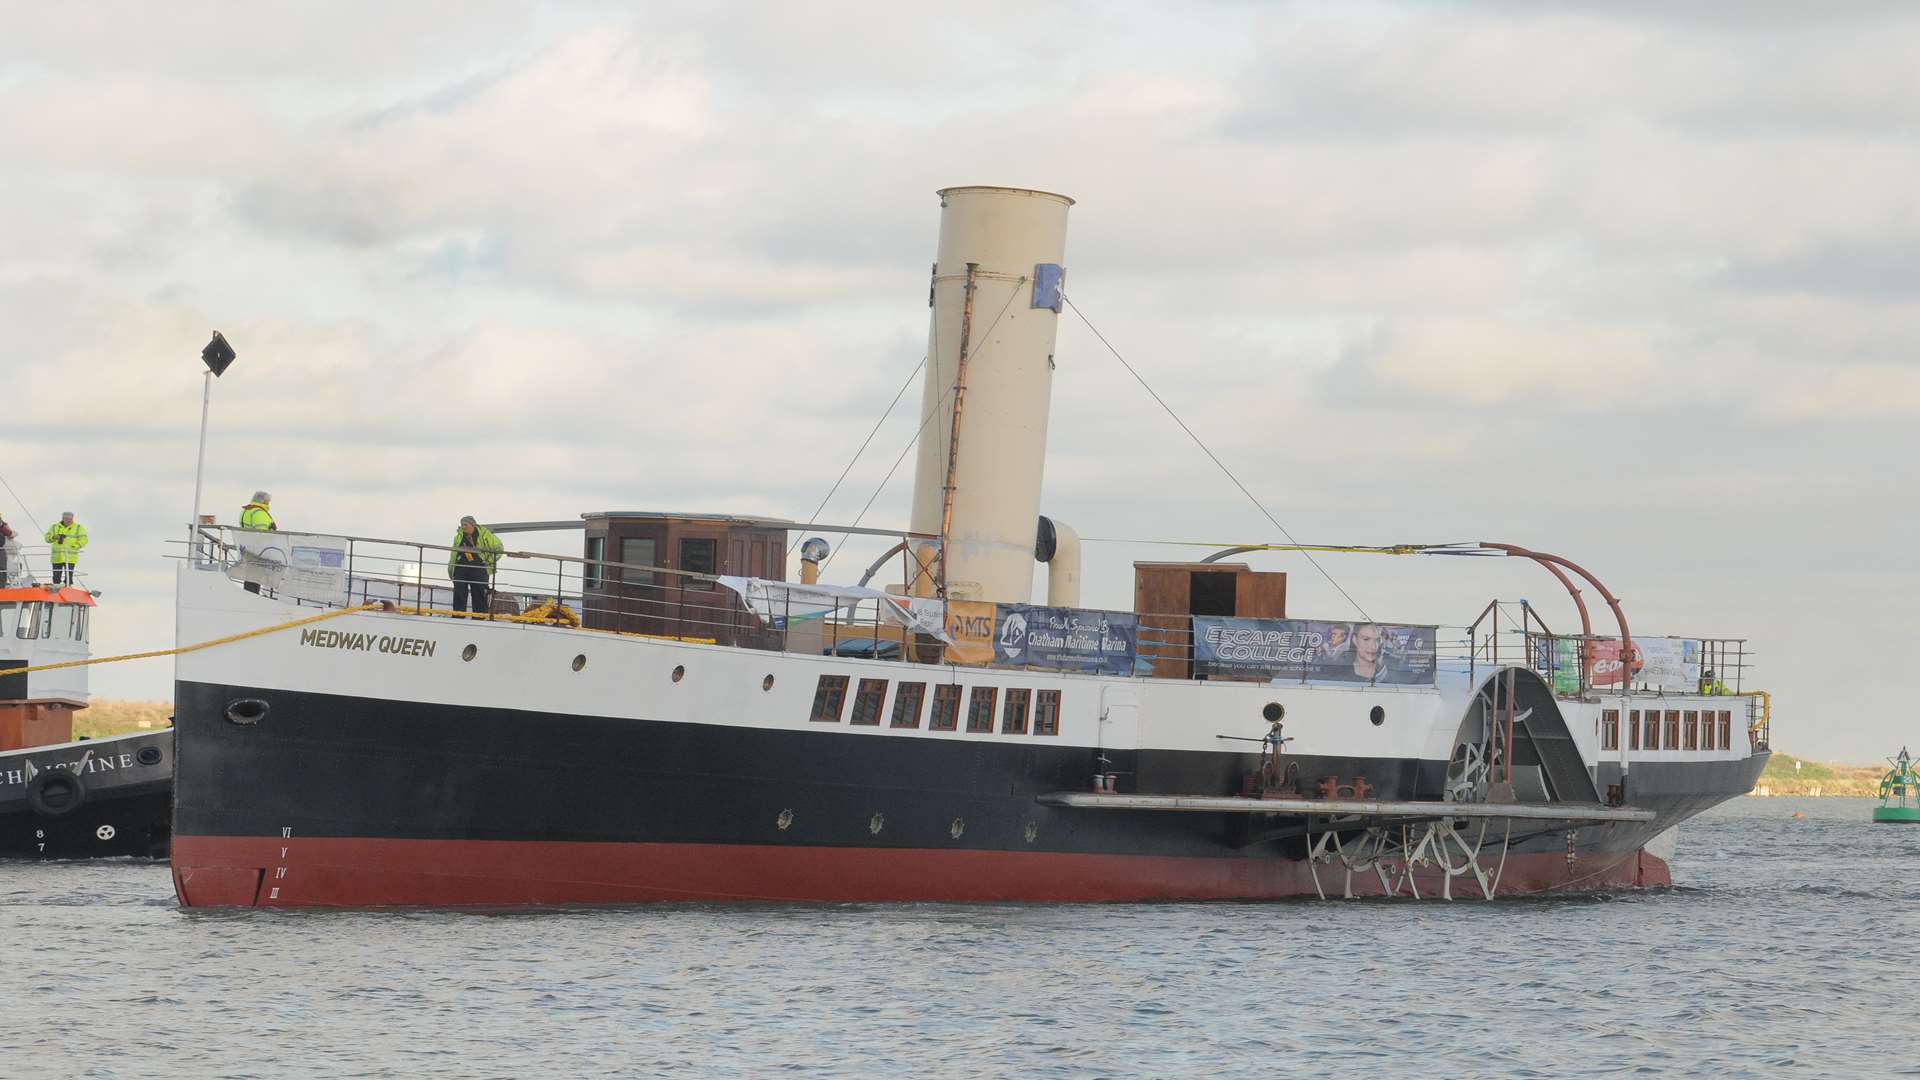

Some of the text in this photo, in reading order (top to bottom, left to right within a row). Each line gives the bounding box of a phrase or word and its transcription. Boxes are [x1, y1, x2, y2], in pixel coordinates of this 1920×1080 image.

[965, 616, 992, 638] MTS
[1028, 631, 1127, 652] Chatham Maritime Marina
[1205, 625, 1323, 647] ESCAPE TO
[300, 628, 437, 658] MEDWAY QUEEN
[1216, 642, 1315, 663] COLLEGE
[36, 829, 45, 839] 8
[282, 826, 292, 839] VI
[37, 843, 45, 852] 7
[281, 847, 289, 859] V
[275, 867, 287, 879] IV
[270, 887, 280, 899] III
